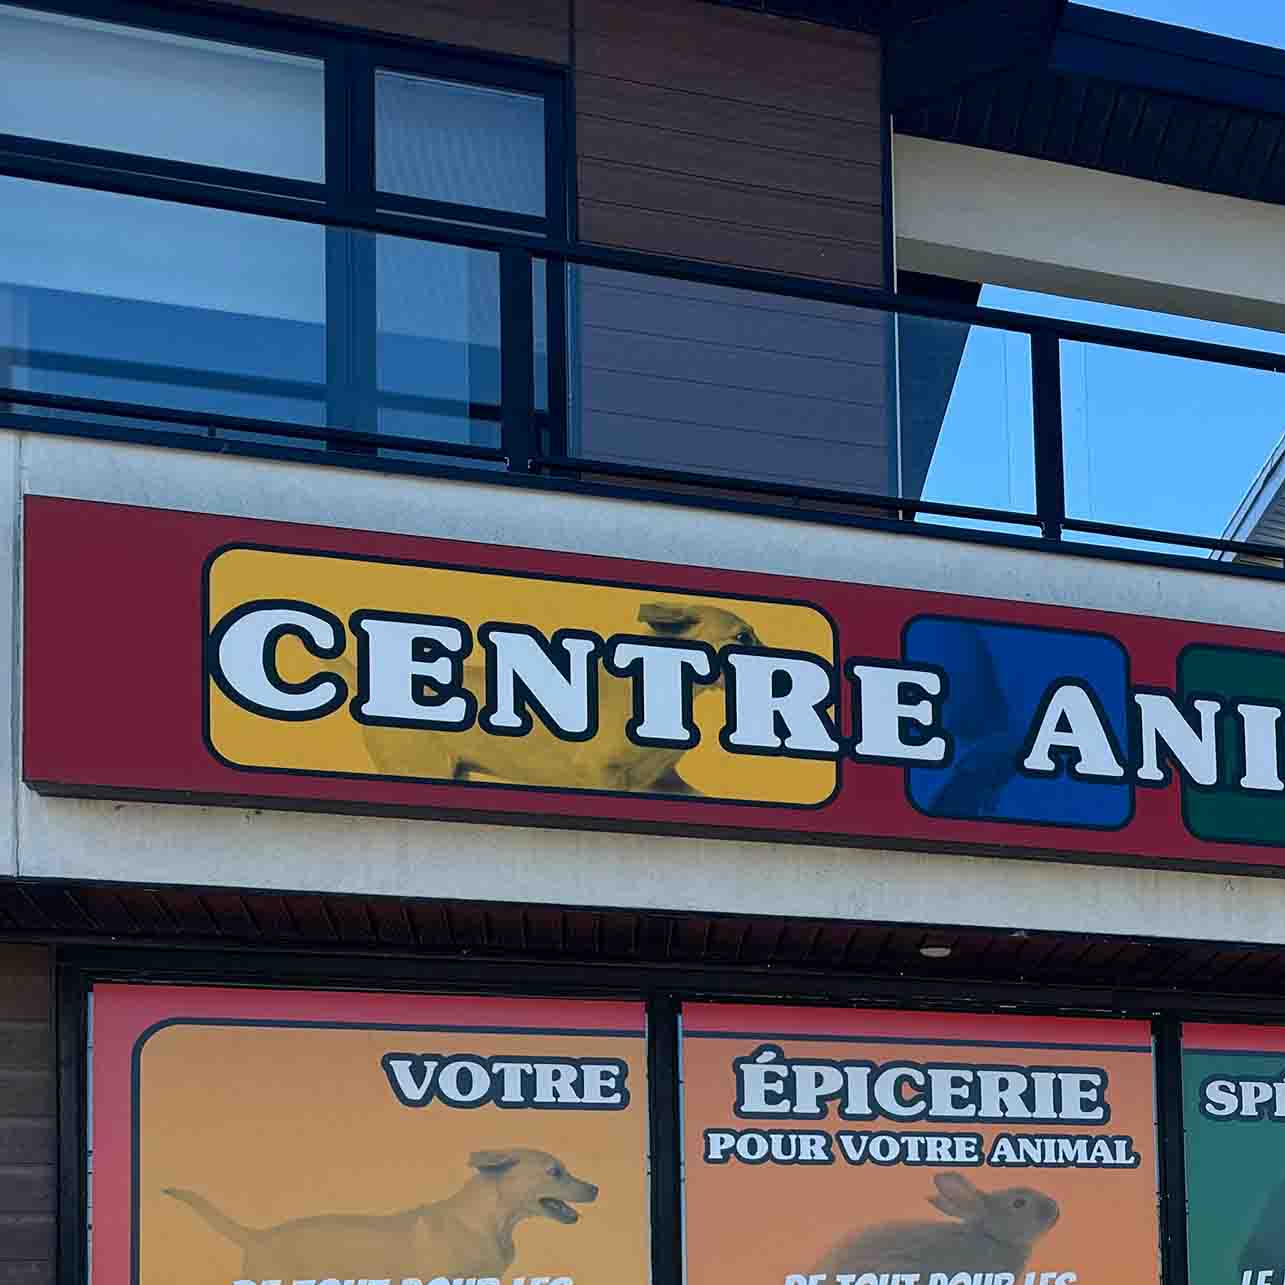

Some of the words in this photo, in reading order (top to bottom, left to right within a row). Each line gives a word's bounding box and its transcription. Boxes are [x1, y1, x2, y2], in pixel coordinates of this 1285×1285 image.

[214, 606, 948, 762] CENTRE
[387, 1058, 624, 1105] VOTRE
[738, 1050, 1105, 1121] ÉPICERIE
[706, 1132, 830, 1161] POUR
[838, 1134, 979, 1163] VOTRE
[990, 1137, 1135, 1166] ANIMAL
